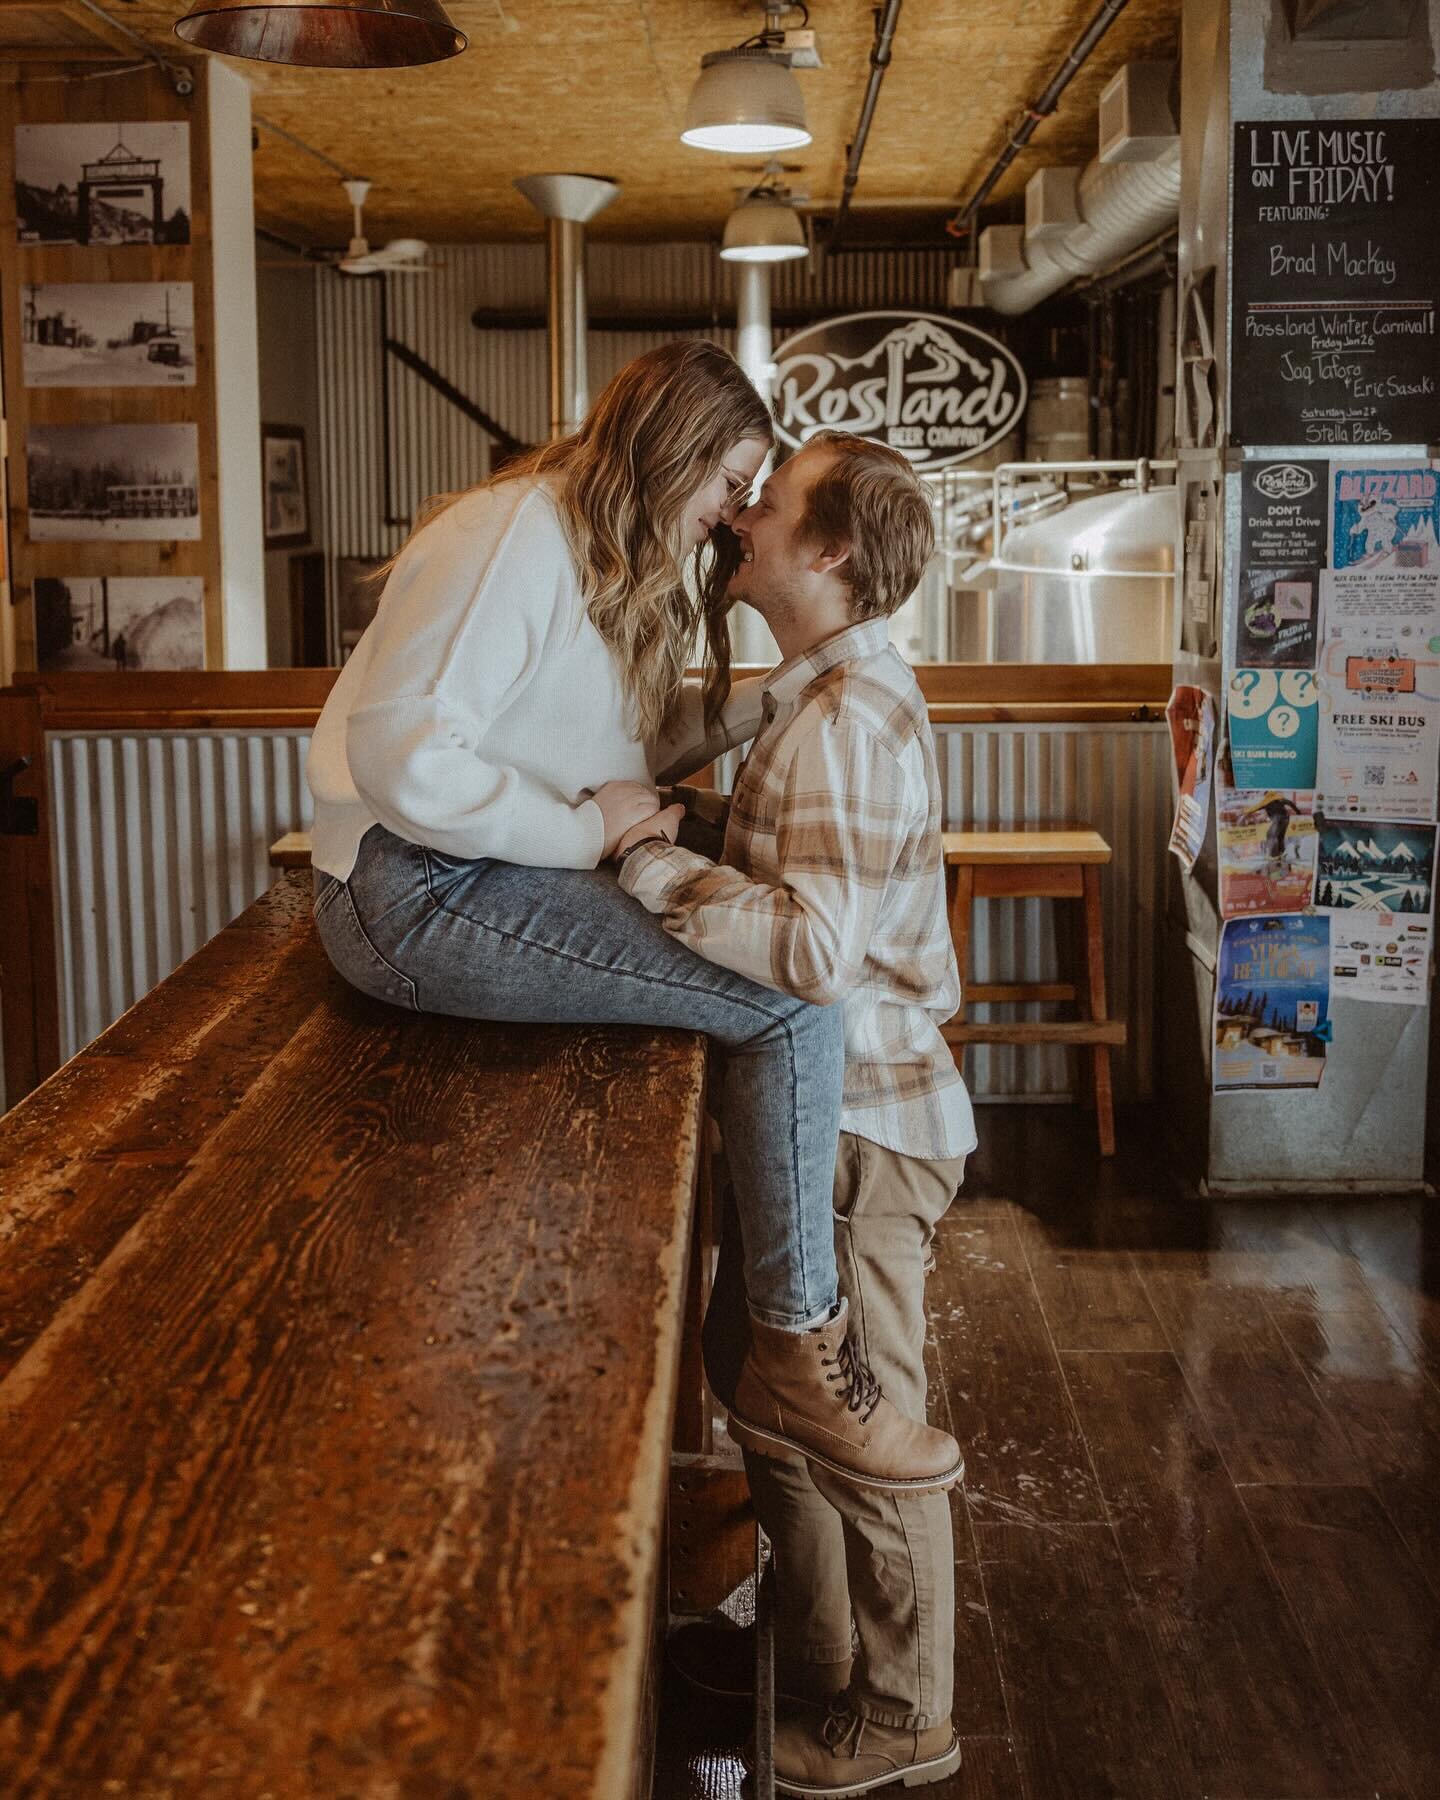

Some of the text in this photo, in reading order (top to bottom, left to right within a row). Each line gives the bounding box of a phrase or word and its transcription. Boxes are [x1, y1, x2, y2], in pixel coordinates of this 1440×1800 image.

[1251, 130, 1388, 167] LIVE MUSIC
[1252, 165, 1394, 204] ON FRIDAY!
[1259, 206, 1330, 222] FEATURING:
[1270, 244, 1316, 276] Brad
[1245, 311, 1435, 336] Rossland Winter Carnival!
[1311, 336, 1342, 350] Friday
[1361, 335, 1375, 346] 26
[773, 340, 1014, 440] Rossland
[1353, 378, 1384, 398] Eric
[888, 427, 986, 448] BEER COMPANY
[1305, 422, 1393, 443] Stella Beats
[1341, 475, 1437, 500] BLIZZARD
[1268, 506, 1302, 516] DON'T
[1248, 517, 1320, 527] Drink and Drive
[1333, 714, 1426, 727] FREE SKI BUS
